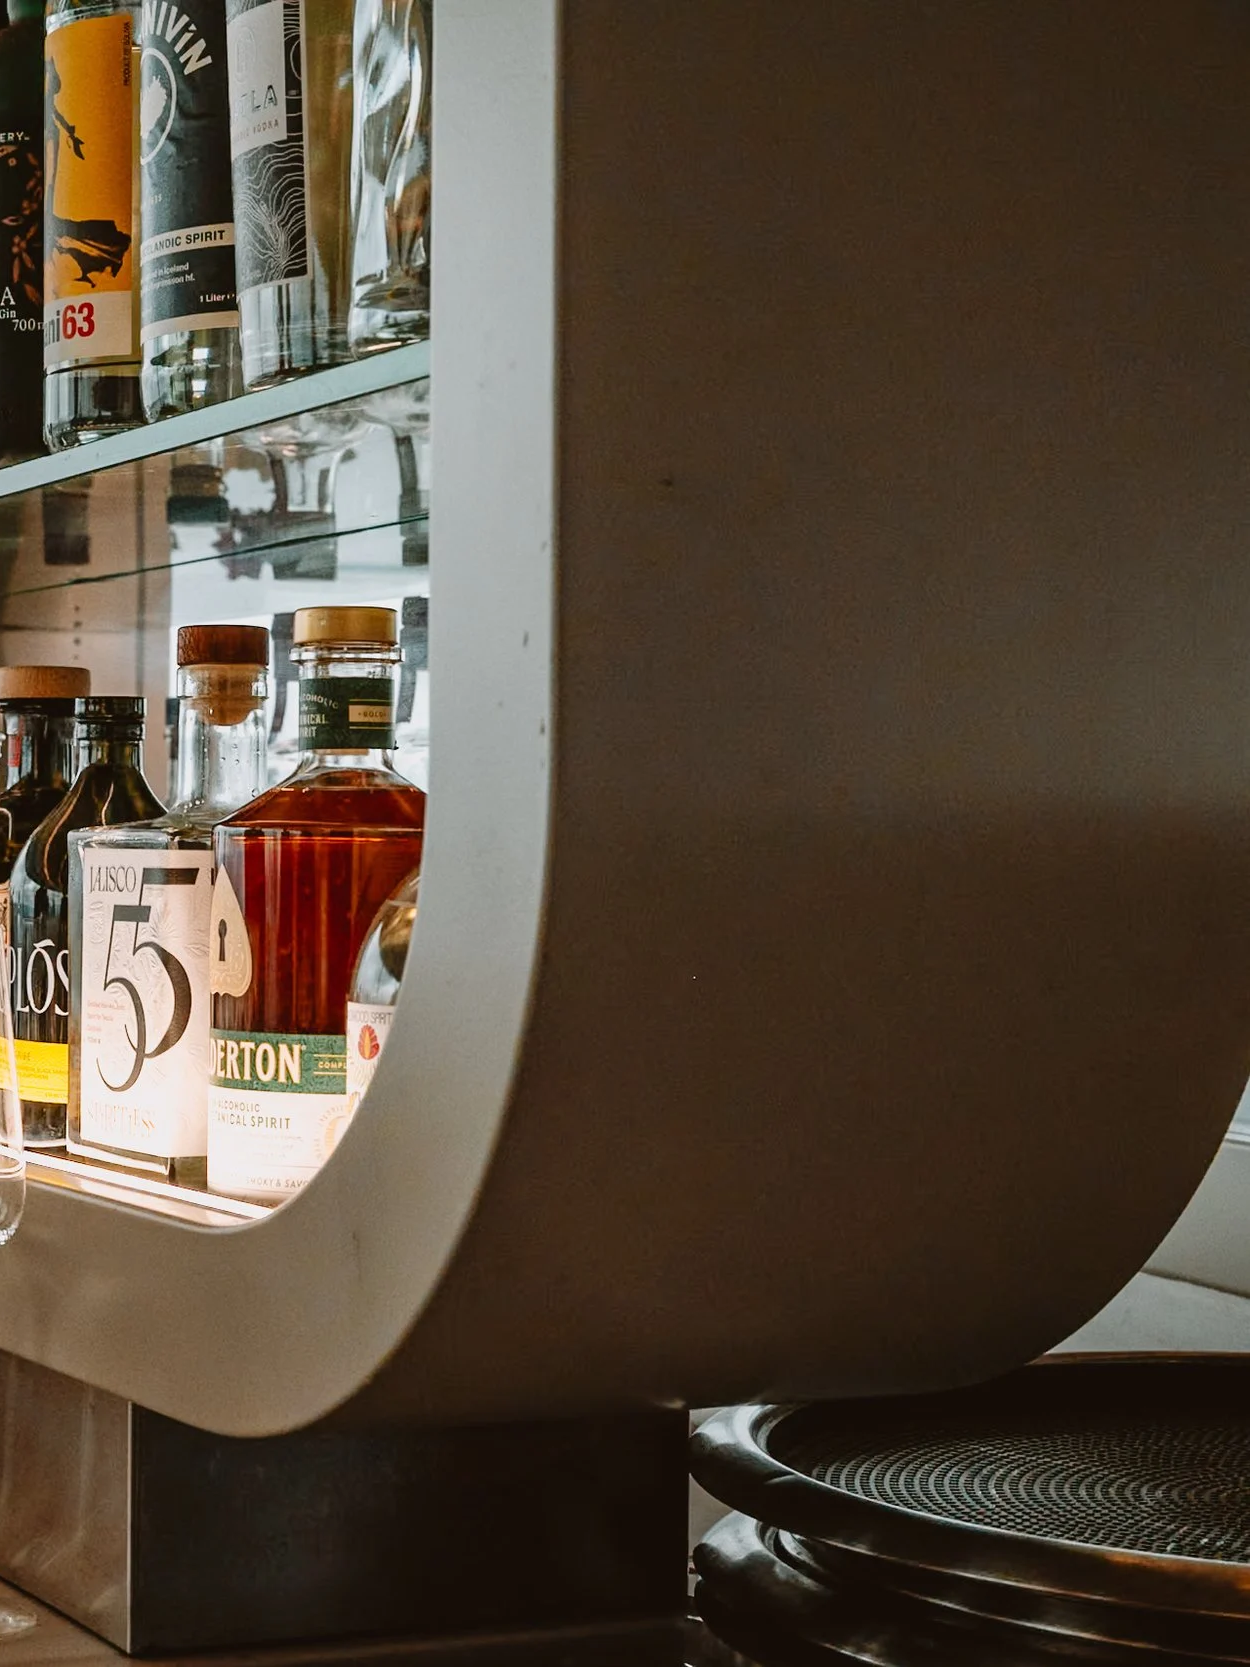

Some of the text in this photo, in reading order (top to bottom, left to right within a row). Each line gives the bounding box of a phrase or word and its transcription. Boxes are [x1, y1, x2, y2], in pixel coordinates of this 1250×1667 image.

[185, 229, 226, 245] SPIRIT
[205, 293, 225, 303] Liter
[12, 318, 36, 331] 700
[89, 865, 137, 893] JALISCO
[251, 1115, 291, 1130] SPIRIT
